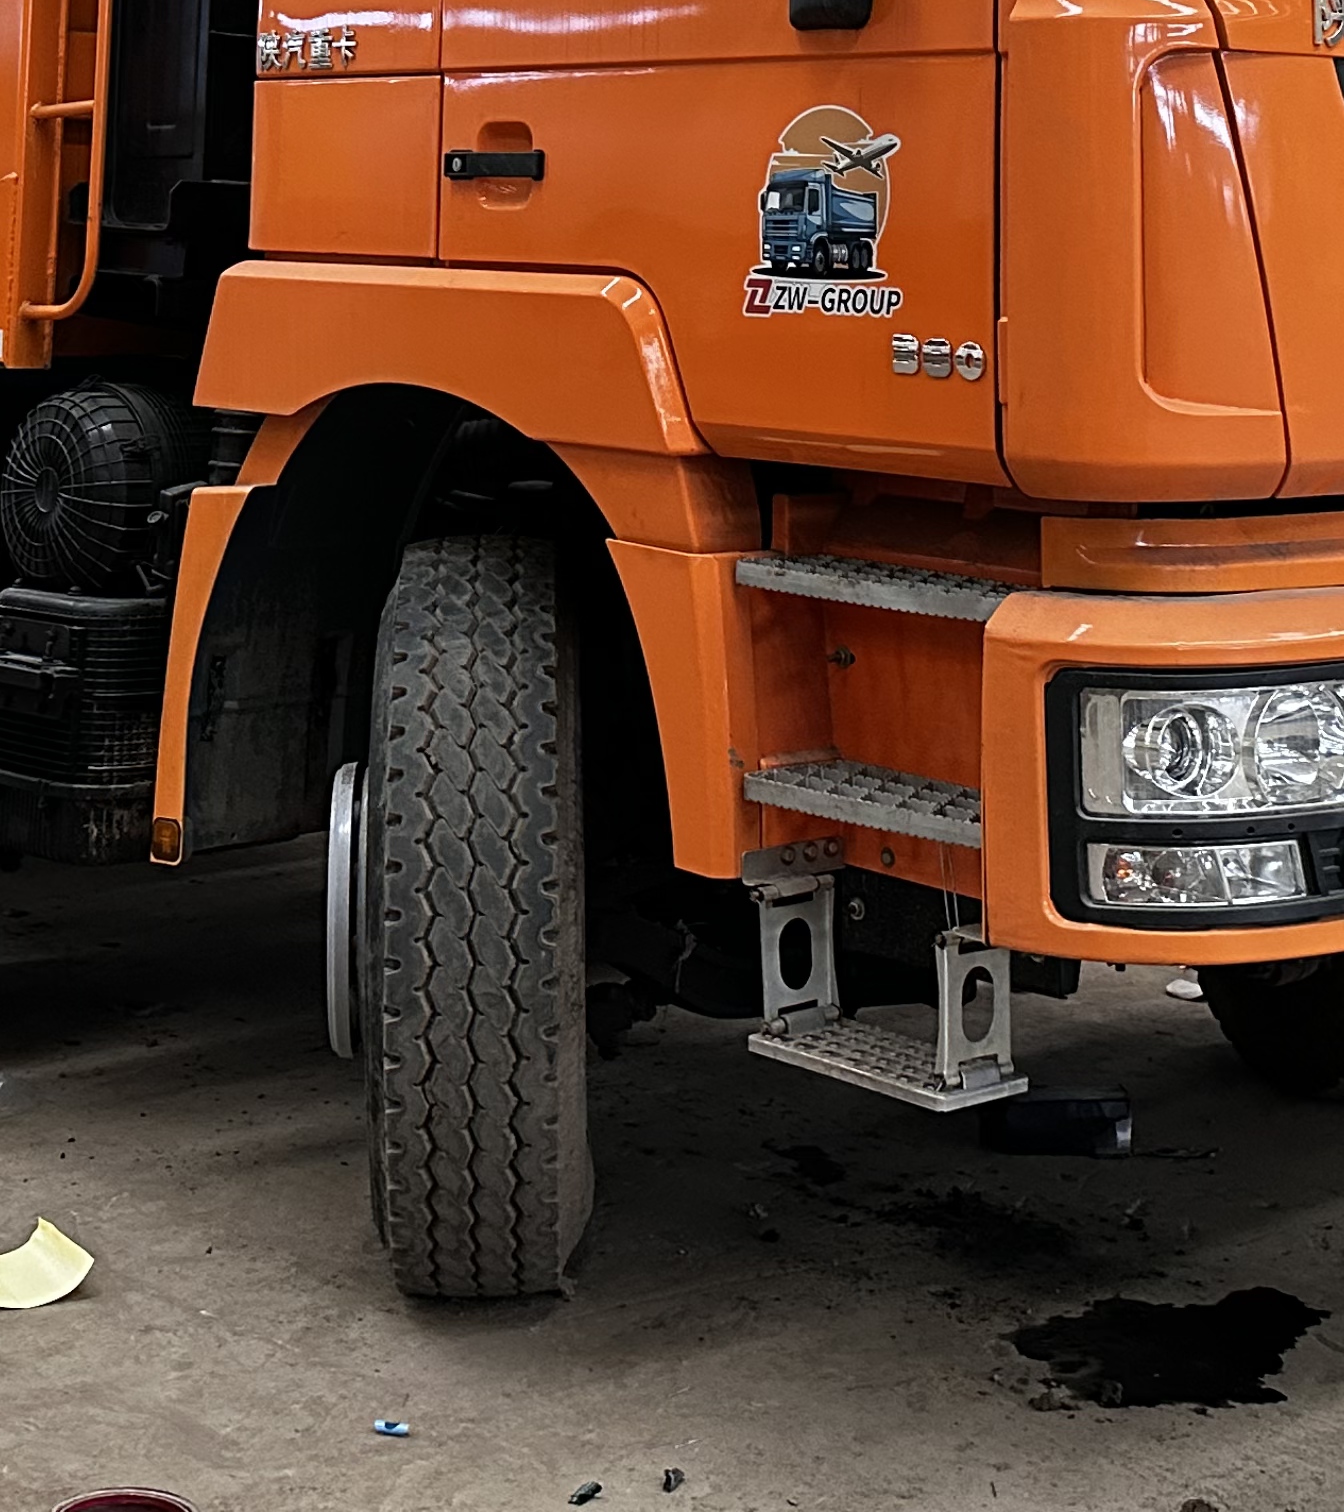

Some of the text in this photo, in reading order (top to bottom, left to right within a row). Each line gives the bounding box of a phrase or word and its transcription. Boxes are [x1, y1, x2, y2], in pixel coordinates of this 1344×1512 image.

[258, 25, 357, 72] 陕汽重卡
[772, 285, 902, 316] ZW-GROUP
